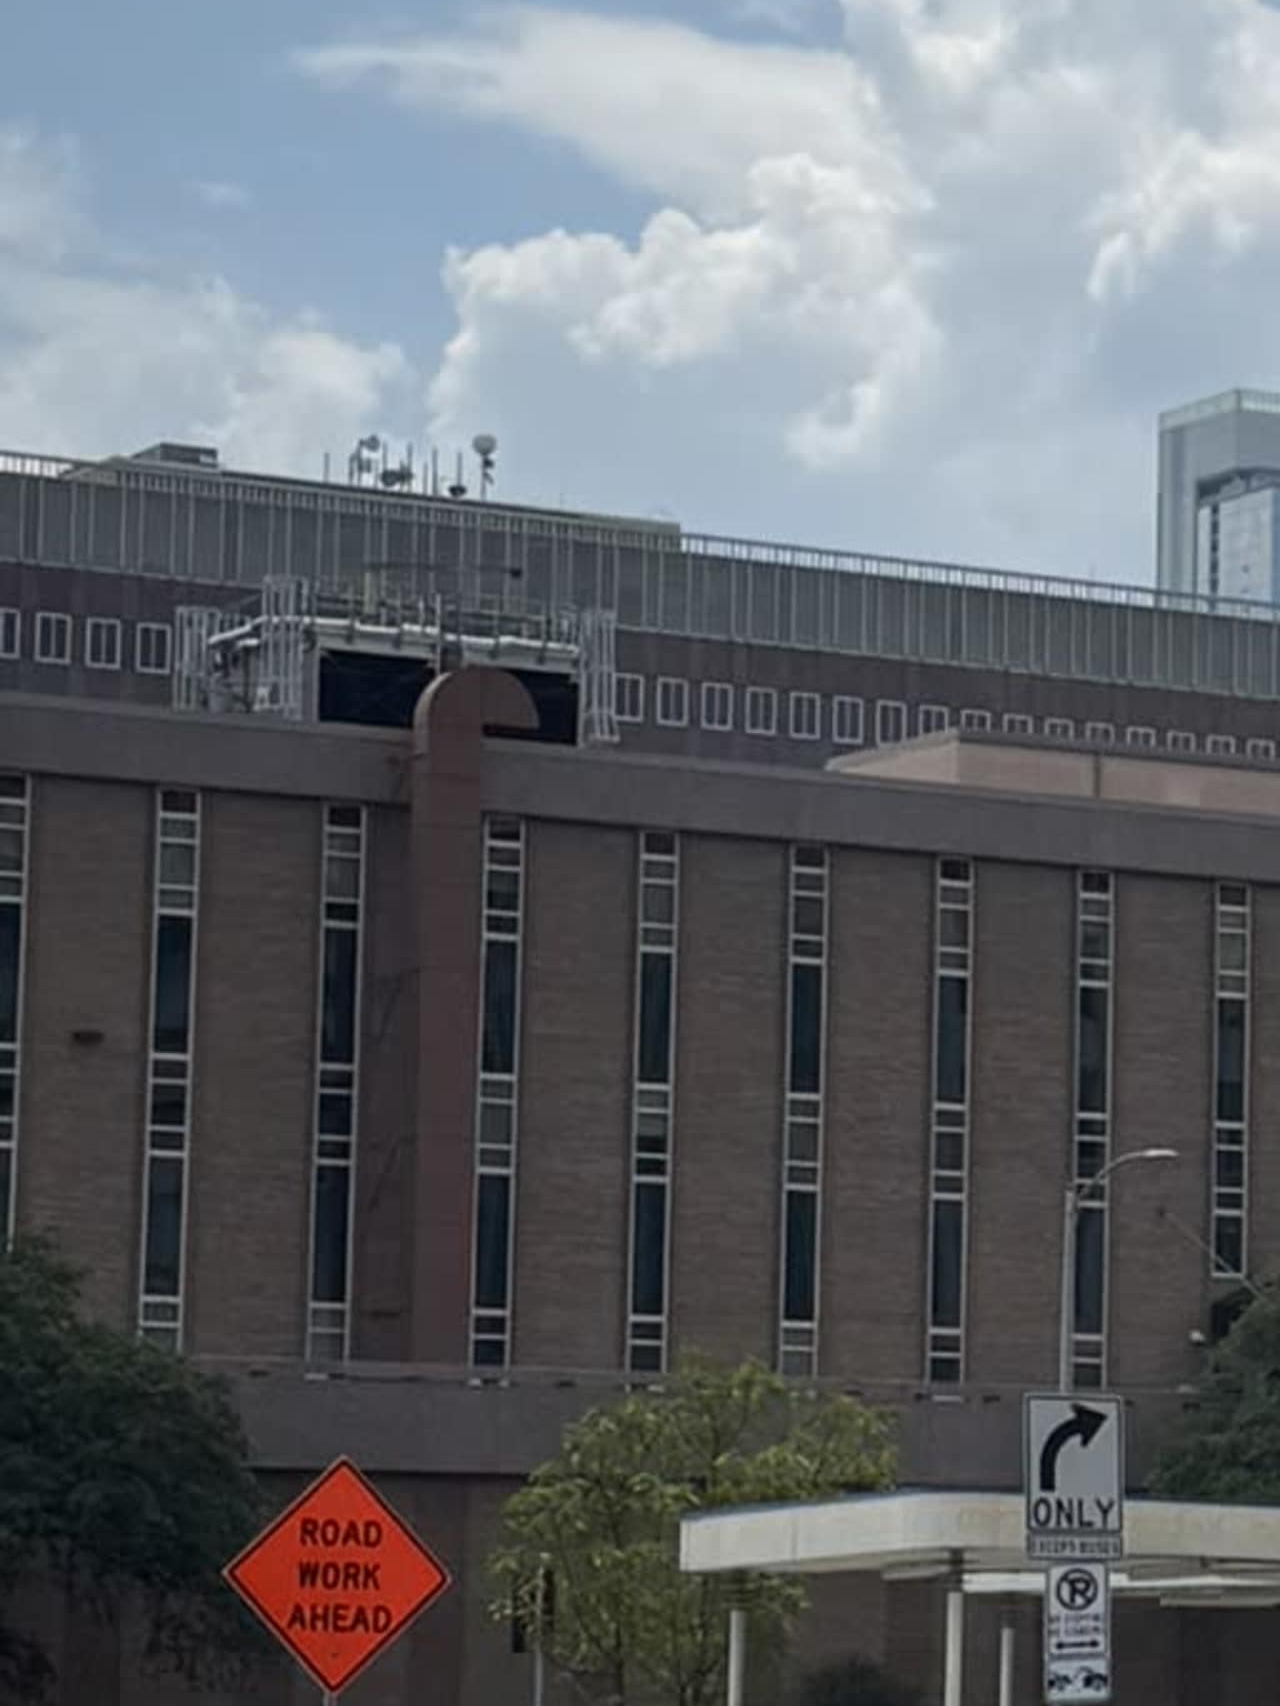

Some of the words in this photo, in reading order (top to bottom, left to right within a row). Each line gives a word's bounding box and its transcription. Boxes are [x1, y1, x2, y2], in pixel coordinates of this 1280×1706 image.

[1033, 1497, 1115, 1528] ONLY
[300, 1517, 382, 1547] ROAD
[299, 1560, 381, 1590] WORK
[288, 1603, 392, 1633] AHEAD
